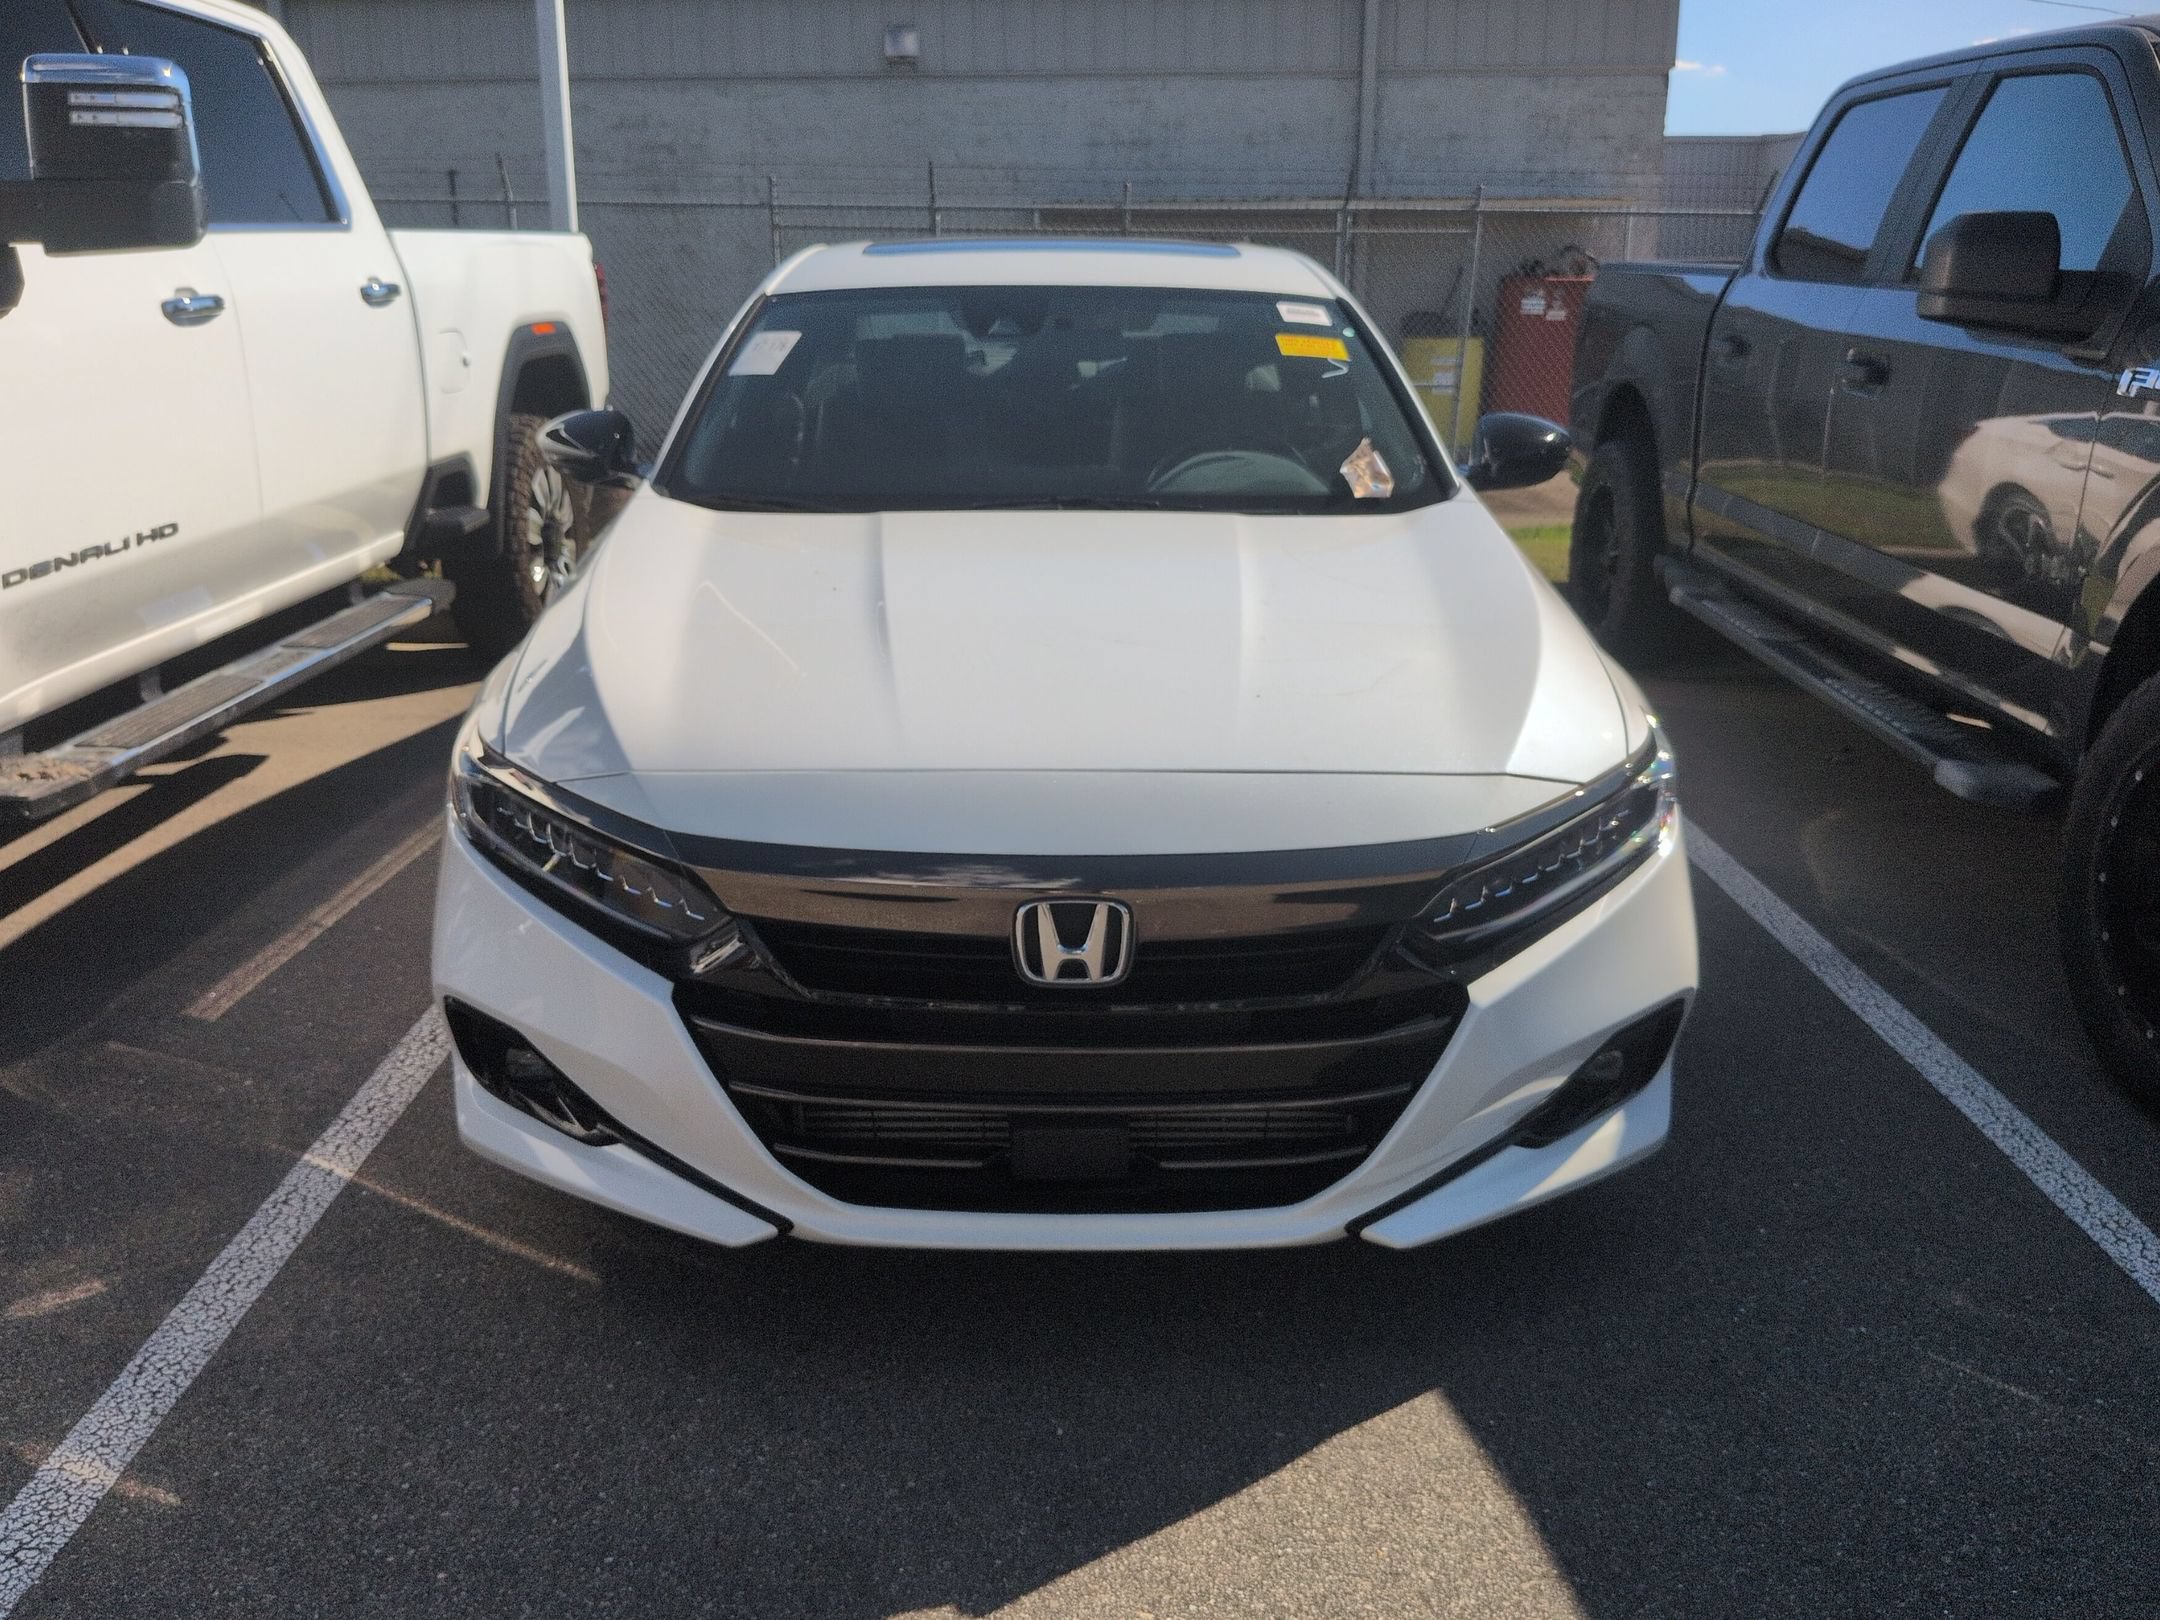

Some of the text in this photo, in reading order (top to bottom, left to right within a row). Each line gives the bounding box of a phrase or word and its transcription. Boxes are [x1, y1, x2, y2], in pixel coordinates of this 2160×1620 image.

[2116, 367, 2160, 397] F
[2, 522, 179, 589] DENALI HD
